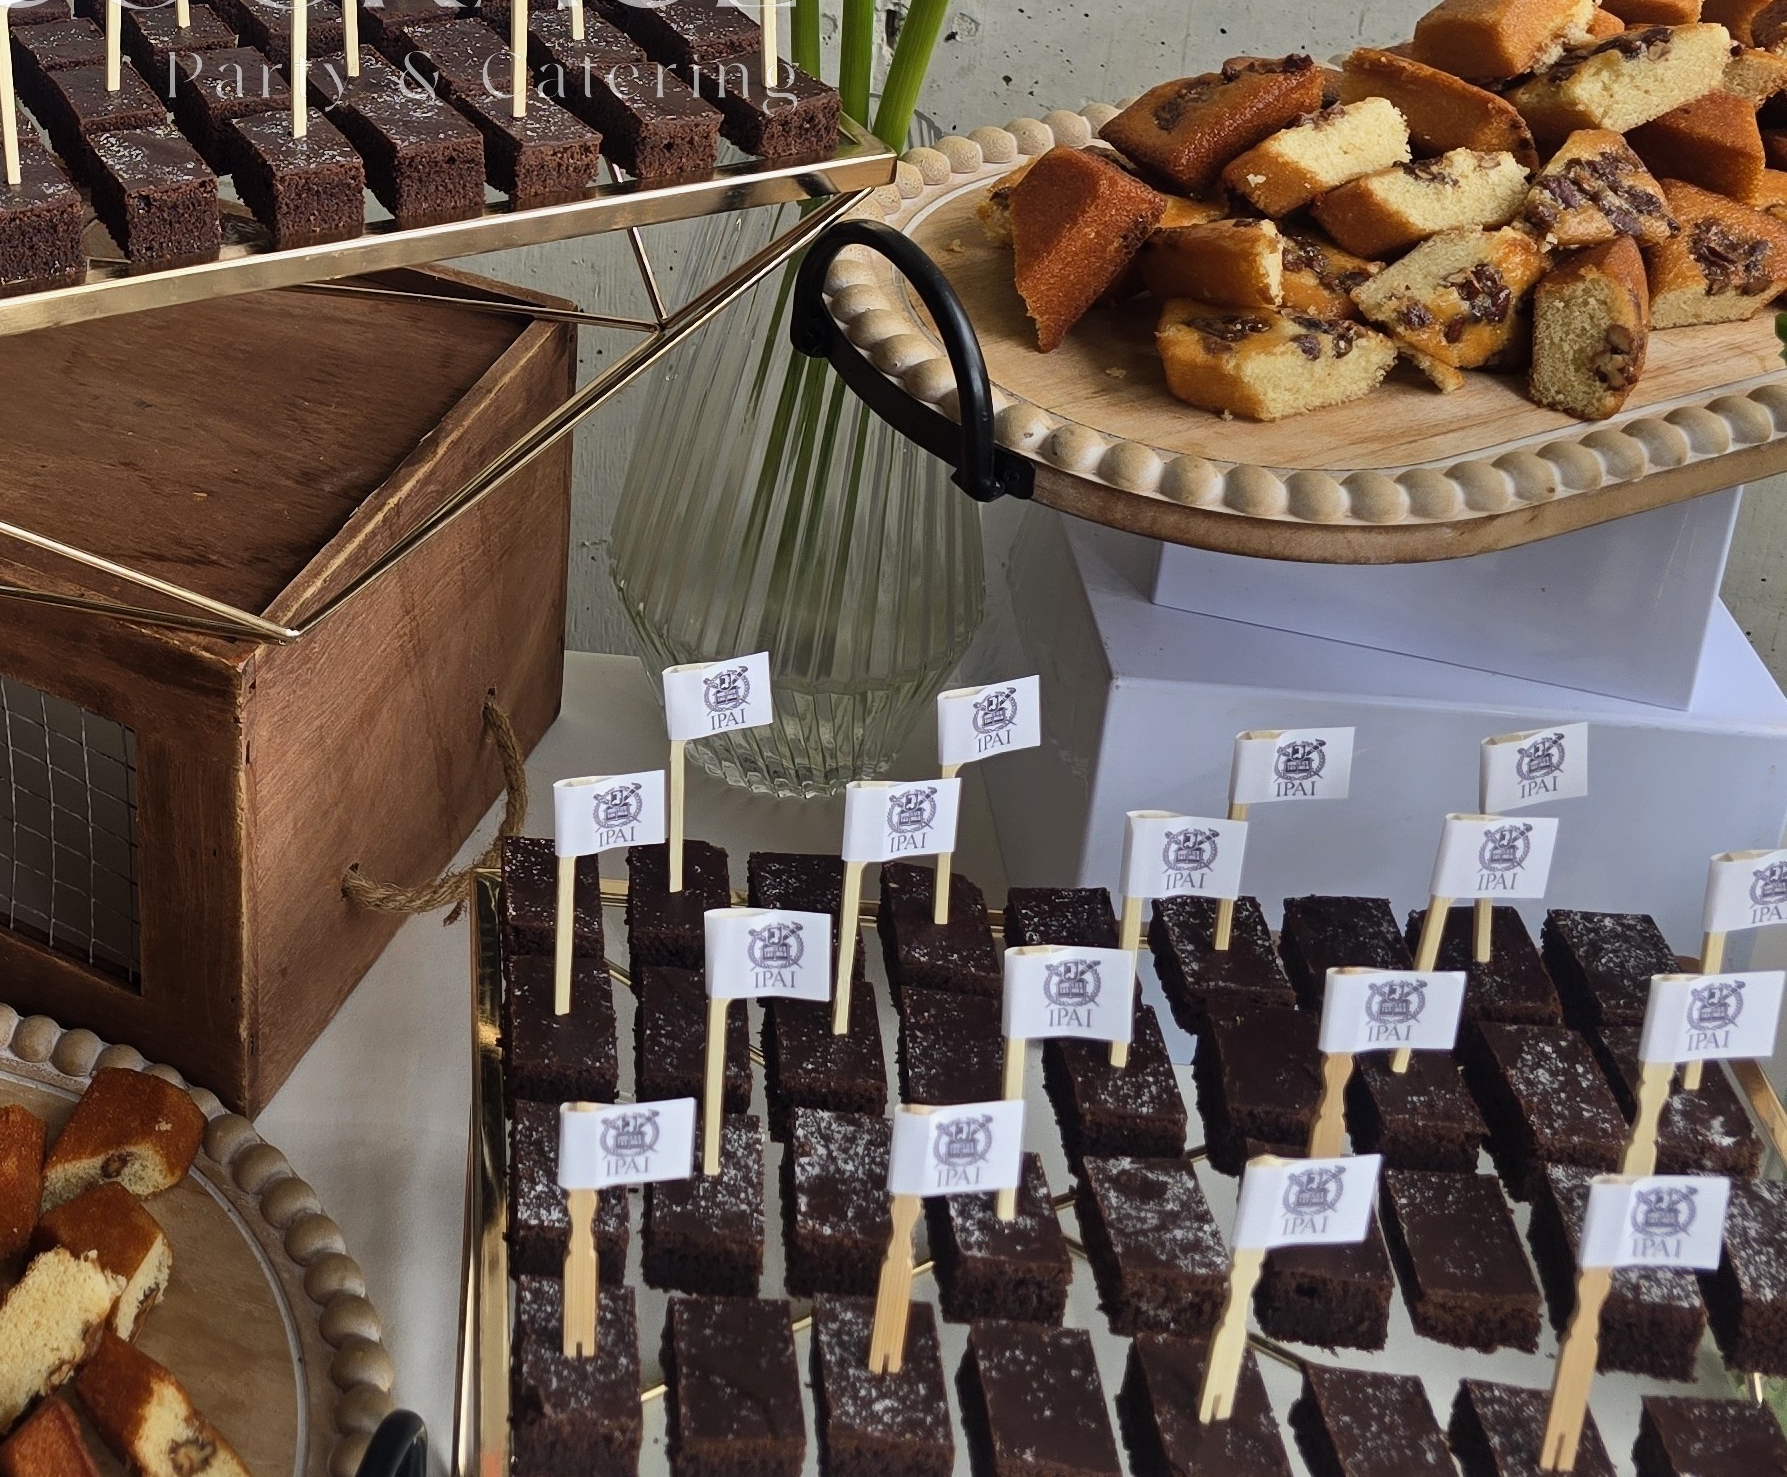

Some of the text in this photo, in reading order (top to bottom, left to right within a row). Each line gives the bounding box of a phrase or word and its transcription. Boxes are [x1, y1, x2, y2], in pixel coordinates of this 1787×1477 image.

[711, 709, 746, 730] IPAI
[978, 729, 1010, 752] IPAI
[1276, 780, 1315, 796] IPAI
[1520, 776, 1557, 798] IPAI
[599, 826, 634, 847] IPAI
[891, 833, 925, 852] IPAI
[1165, 872, 1205, 890] IPAI
[1477, 872, 1515, 890] IPAI
[1751, 904, 1787, 924] IPA
[755, 971, 796, 988] IPAI
[1050, 1008, 1091, 1028] IPAI
[1368, 1024, 1411, 1042] IPAI
[1687, 1030, 1729, 1050] IPAI
[606, 1156, 649, 1176] IPAI
[938, 1165, 981, 1187] IPAI
[1283, 1216, 1327, 1235] IPAI
[1632, 1238, 1681, 1258] IPAI
